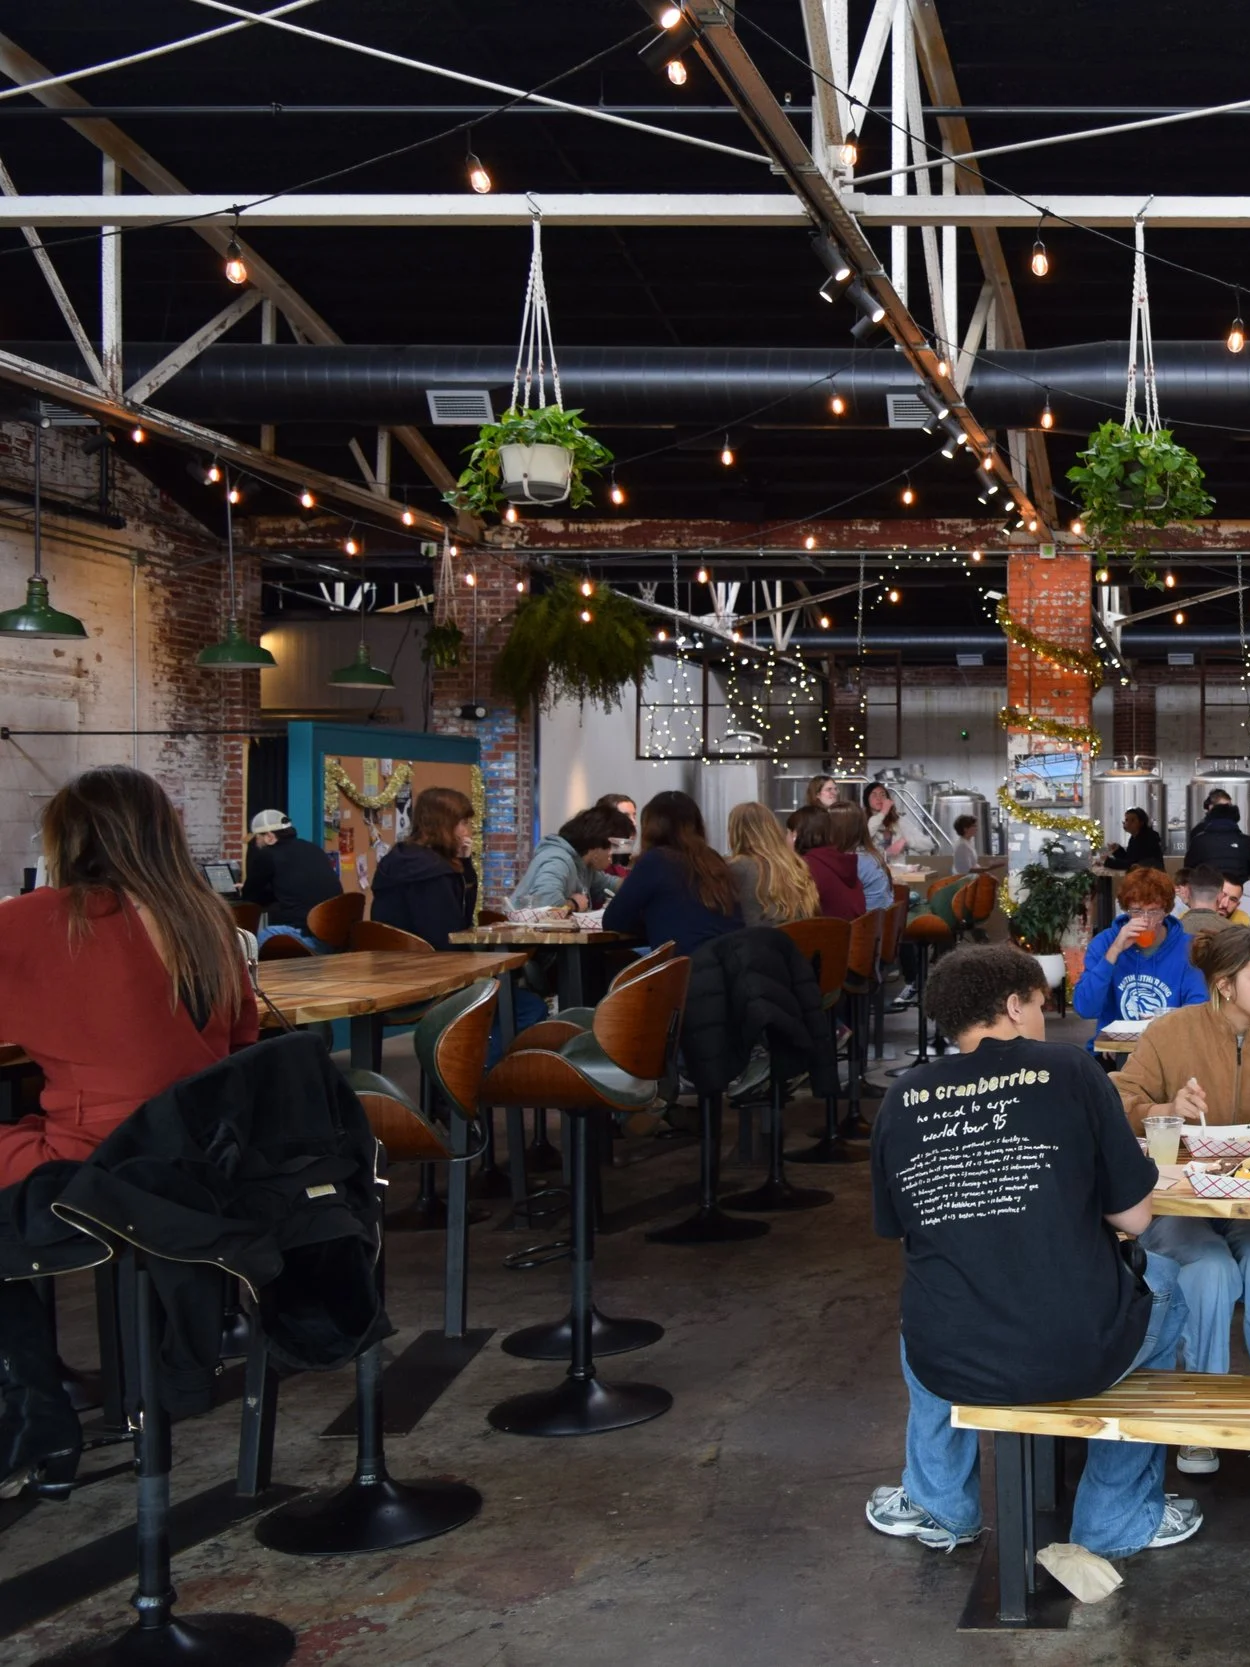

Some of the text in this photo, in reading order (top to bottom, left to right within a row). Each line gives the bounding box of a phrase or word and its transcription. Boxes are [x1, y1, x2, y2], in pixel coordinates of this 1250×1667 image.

[903, 1068, 1050, 1107] the cranberries
[916, 1097, 1020, 1124] no need to argue
[922, 1113, 1008, 1142] world tour 95
